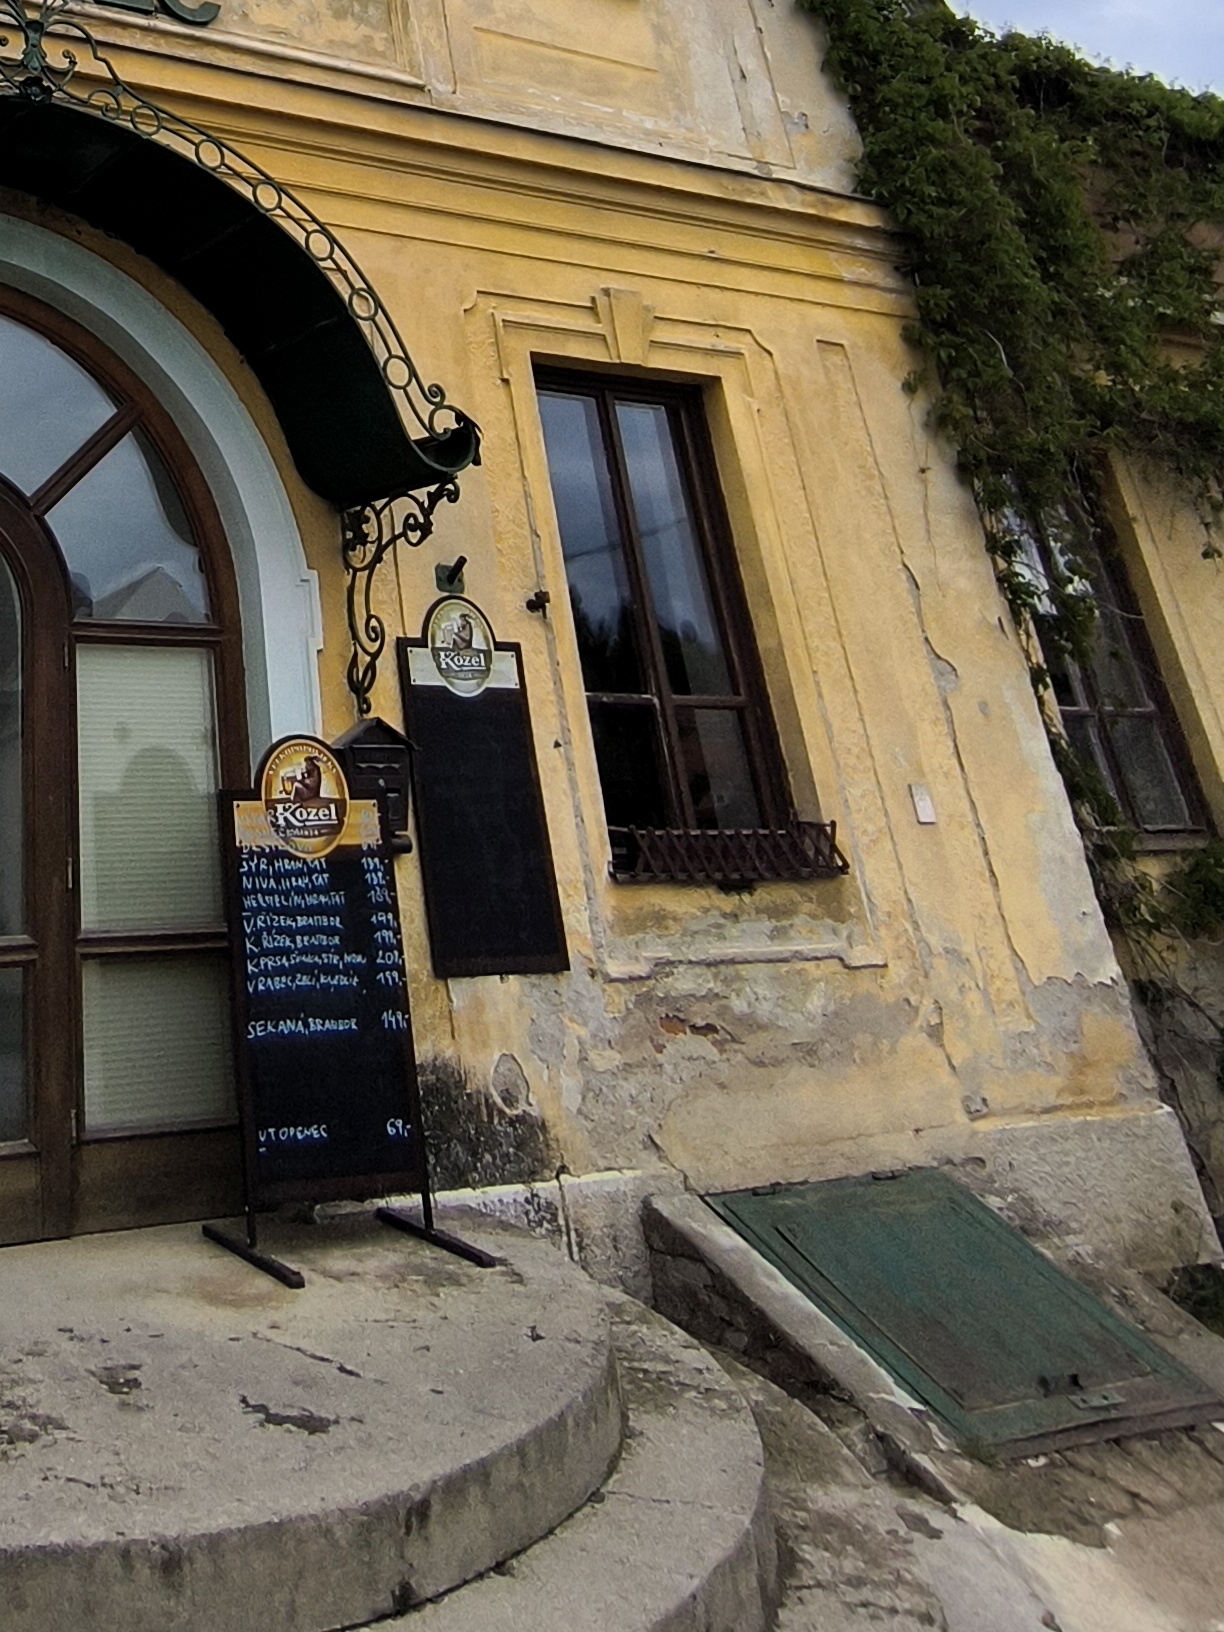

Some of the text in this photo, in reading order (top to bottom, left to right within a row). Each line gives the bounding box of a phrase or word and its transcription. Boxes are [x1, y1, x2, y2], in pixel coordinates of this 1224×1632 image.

[438, 650, 486, 671] Kozel
[274, 802, 338, 827] Kozel
[258, 1123, 328, 1142] UTOPENEC
